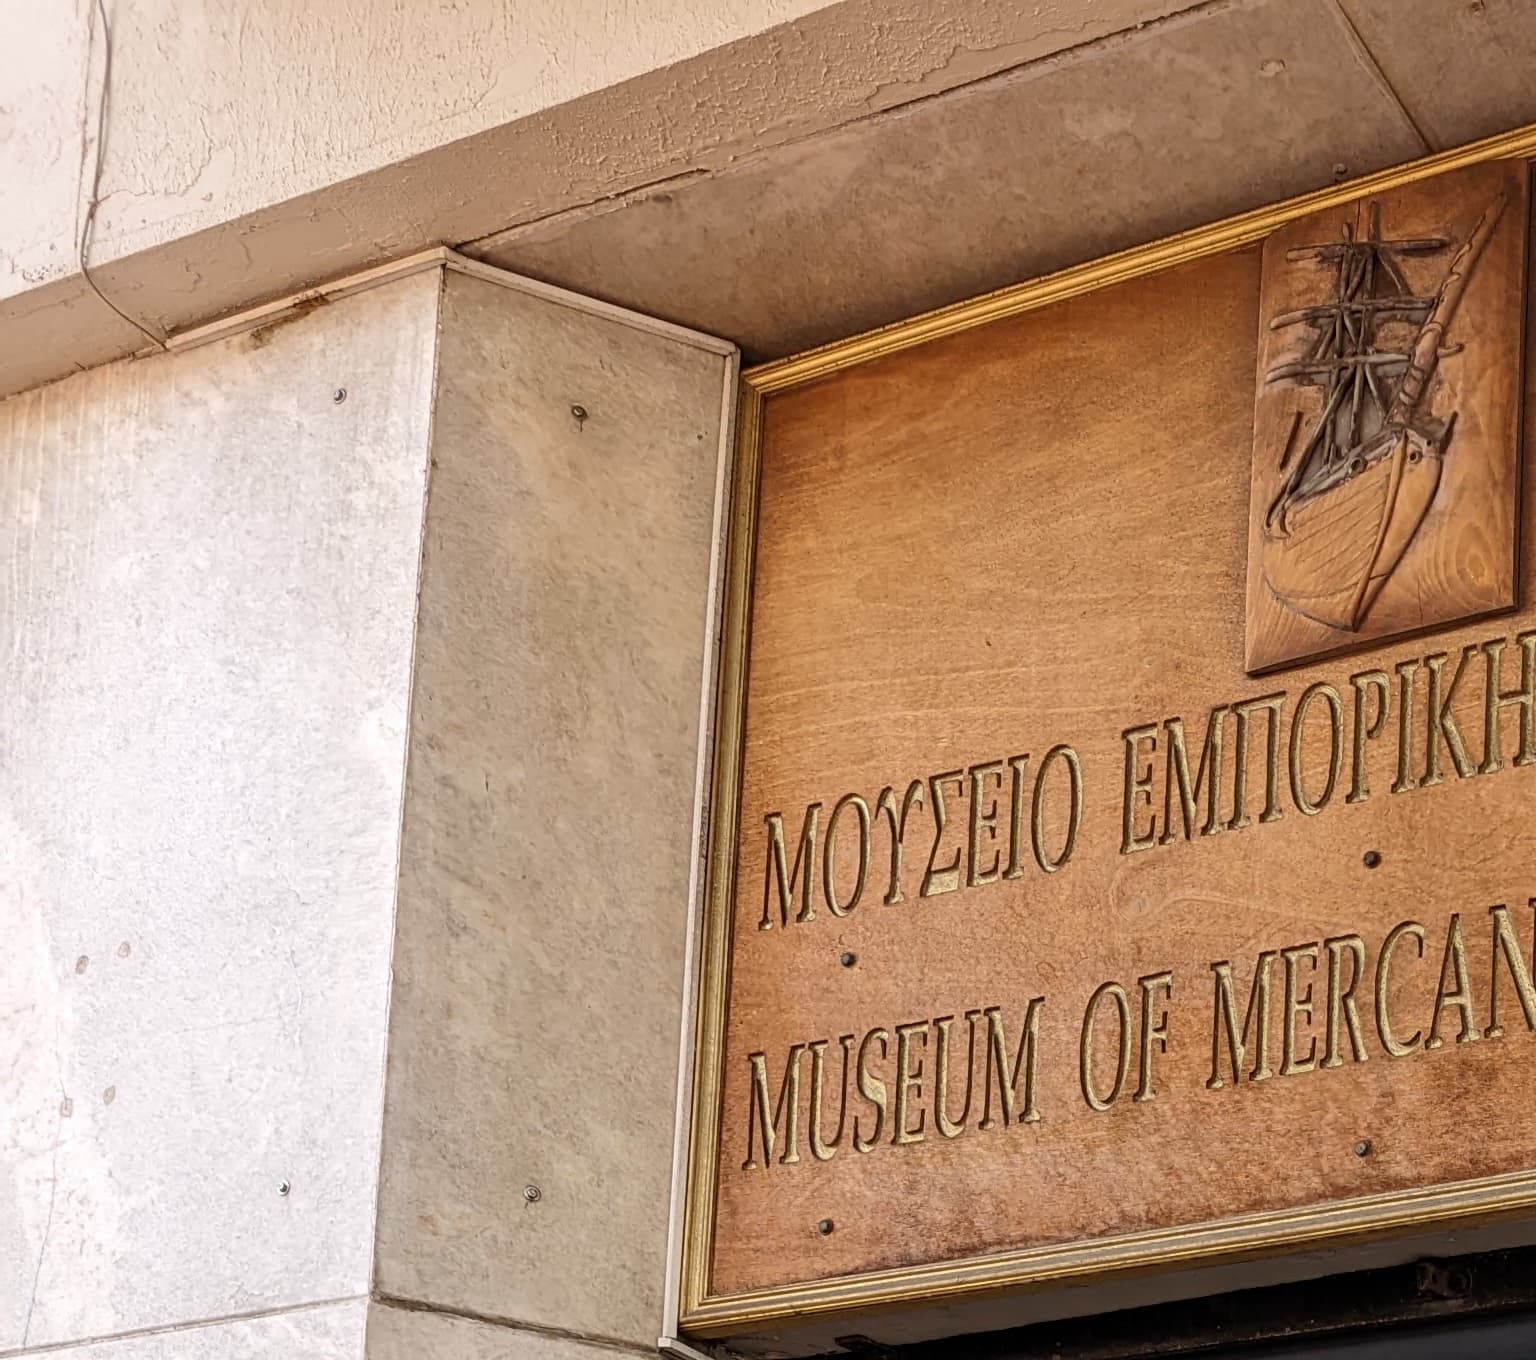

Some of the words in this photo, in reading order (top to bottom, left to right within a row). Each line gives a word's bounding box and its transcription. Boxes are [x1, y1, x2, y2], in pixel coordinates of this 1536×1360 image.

[758, 743, 1083, 931] ΜΟΥΣΕΙΟ
[741, 995, 1046, 1171] MUSEUM
[1079, 969, 1173, 1112] OF
